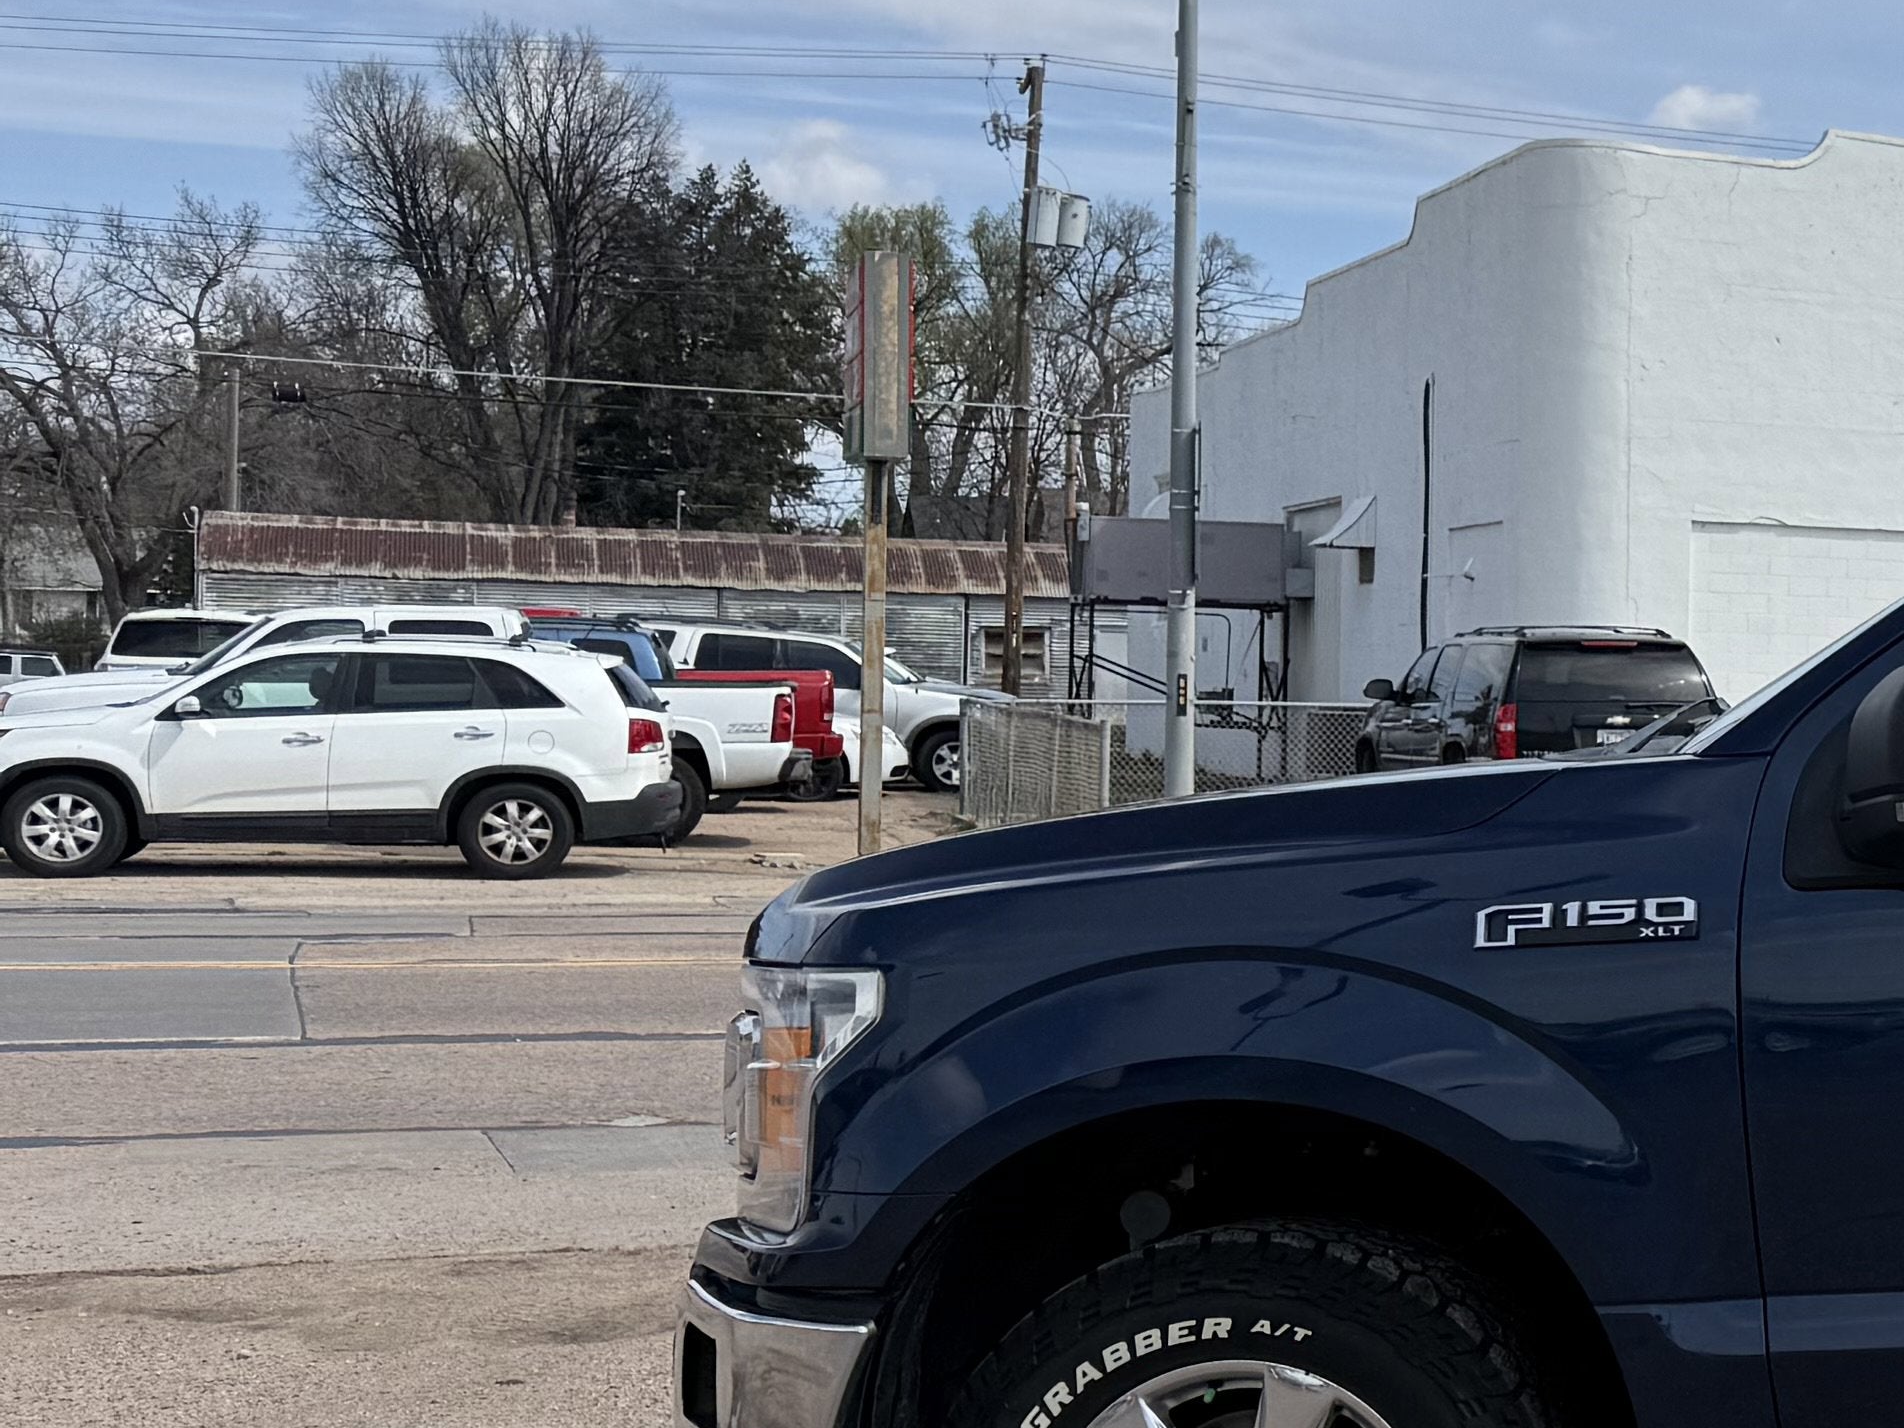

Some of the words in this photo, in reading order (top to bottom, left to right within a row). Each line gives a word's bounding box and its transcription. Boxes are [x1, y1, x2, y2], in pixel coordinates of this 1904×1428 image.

[1473, 896, 1698, 949] F150
[1639, 924, 1686, 938] XLT
[1250, 1319, 1312, 1342] A/T
